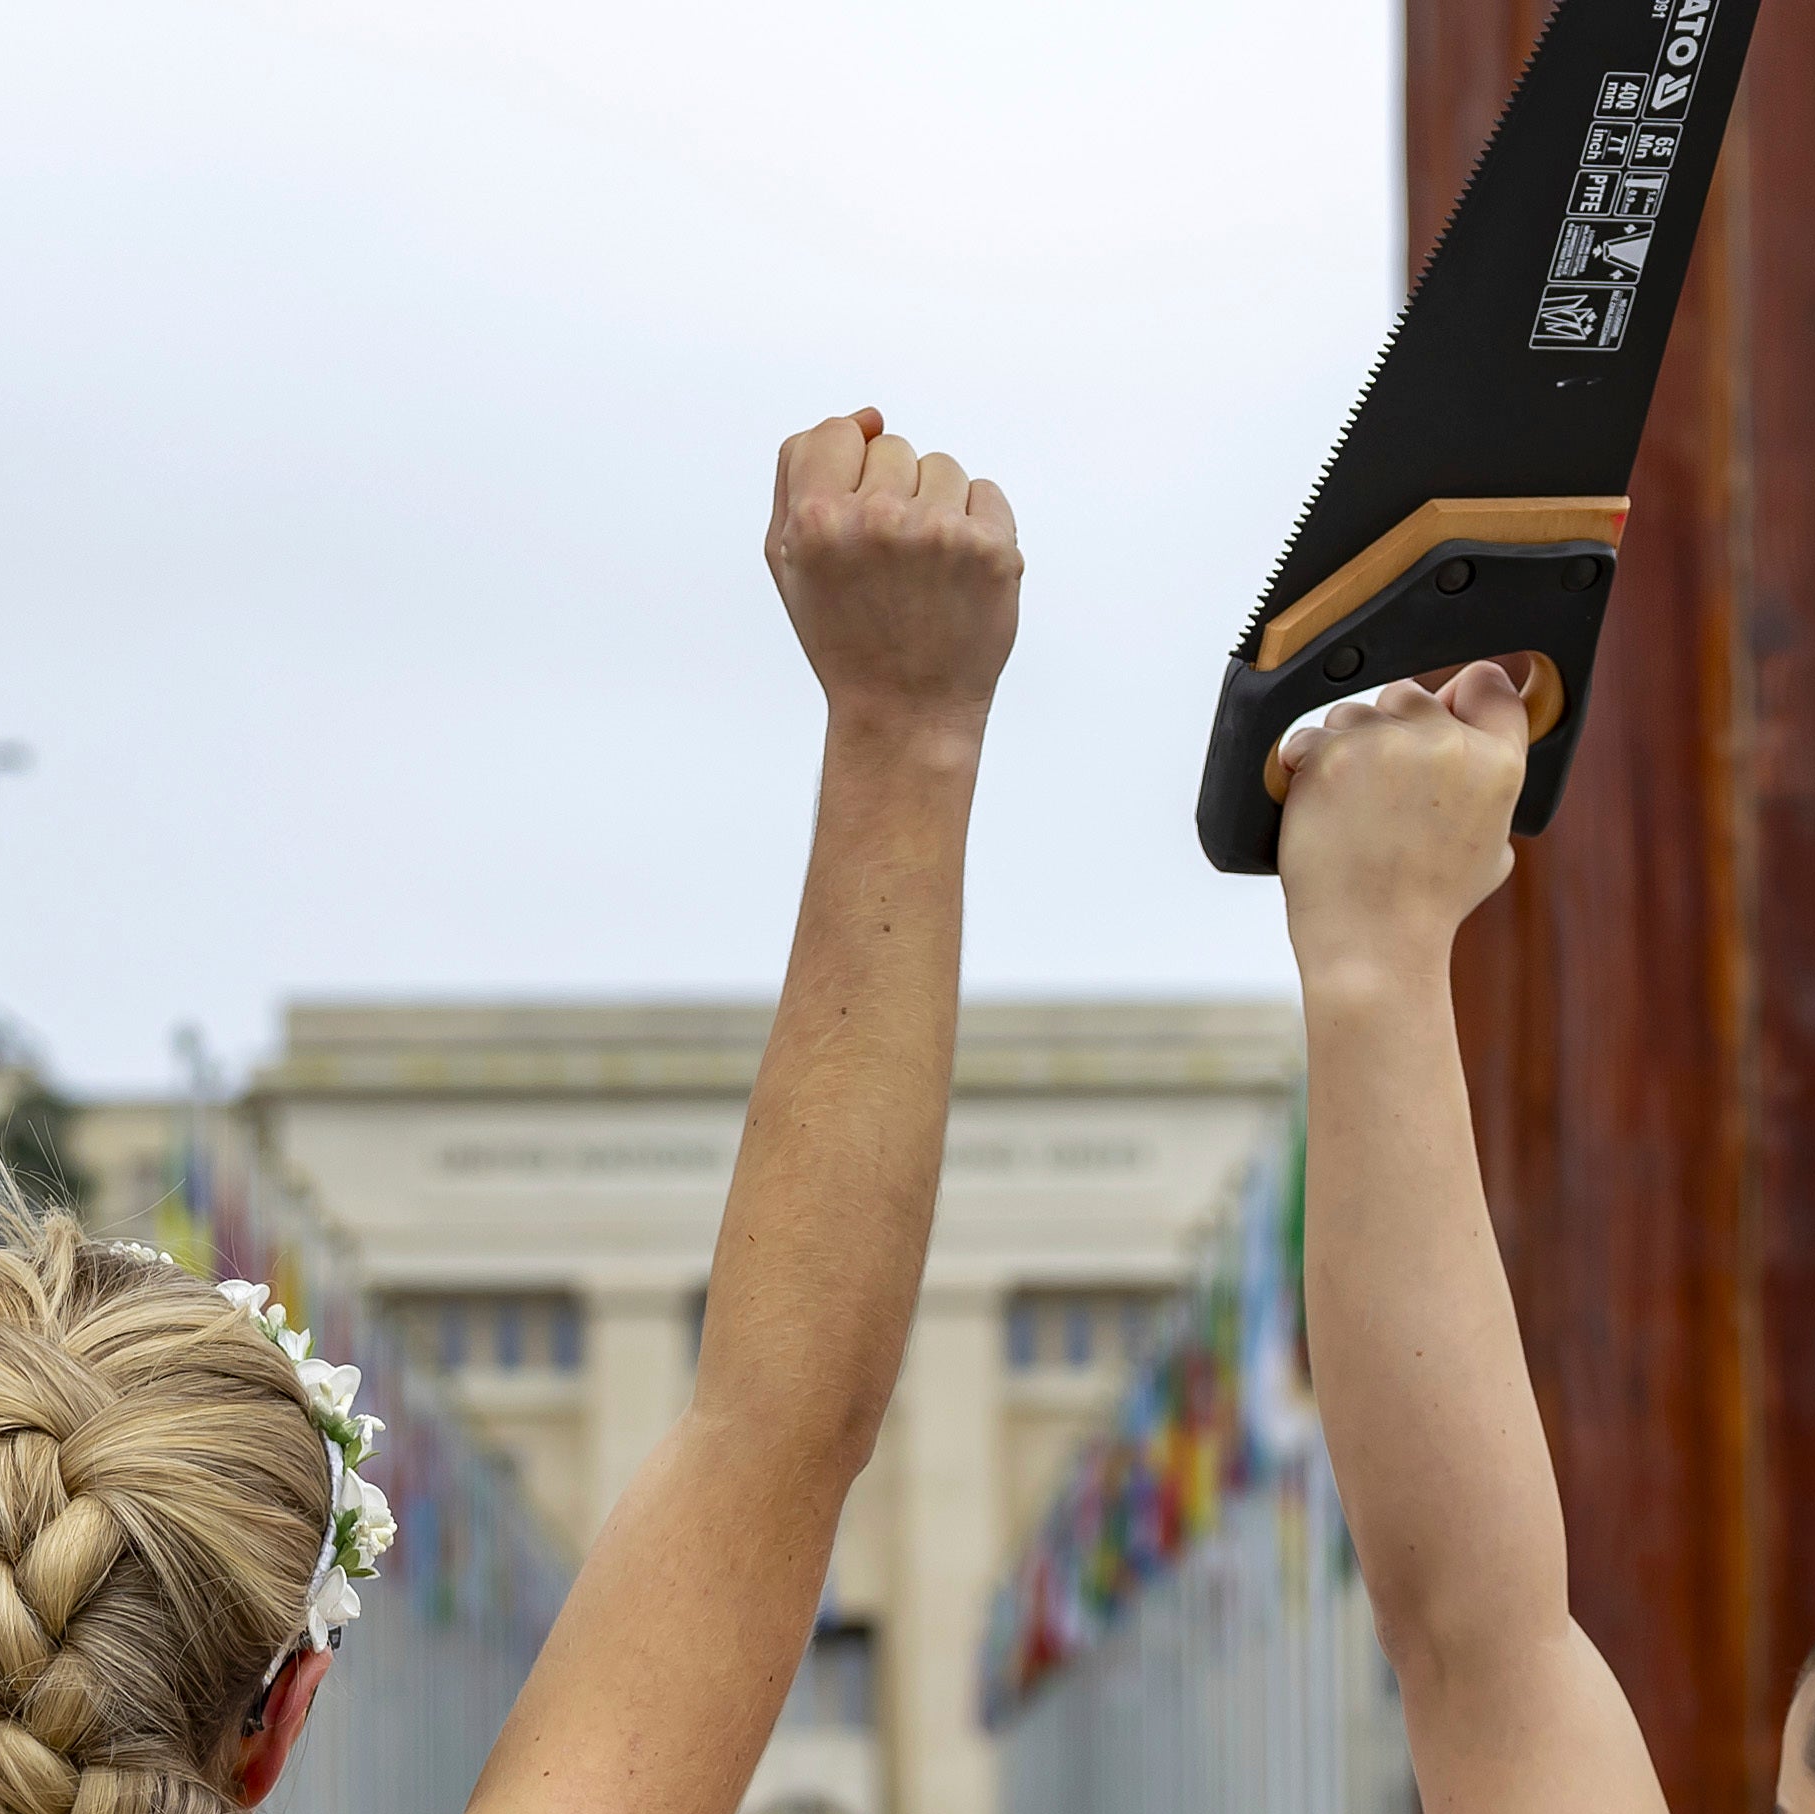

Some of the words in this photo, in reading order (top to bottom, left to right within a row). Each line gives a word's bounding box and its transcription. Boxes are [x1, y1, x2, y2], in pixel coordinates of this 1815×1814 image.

[1602, 81, 1619, 110] mm
[1615, 82, 1640, 110] 400
[1586, 128, 1609, 160] inch
[1607, 135, 1628, 155] 7T
[1634, 134, 1656, 159] Mn
[1652, 136, 1675, 157] 65
[1579, 174, 1609, 212] PTFE
